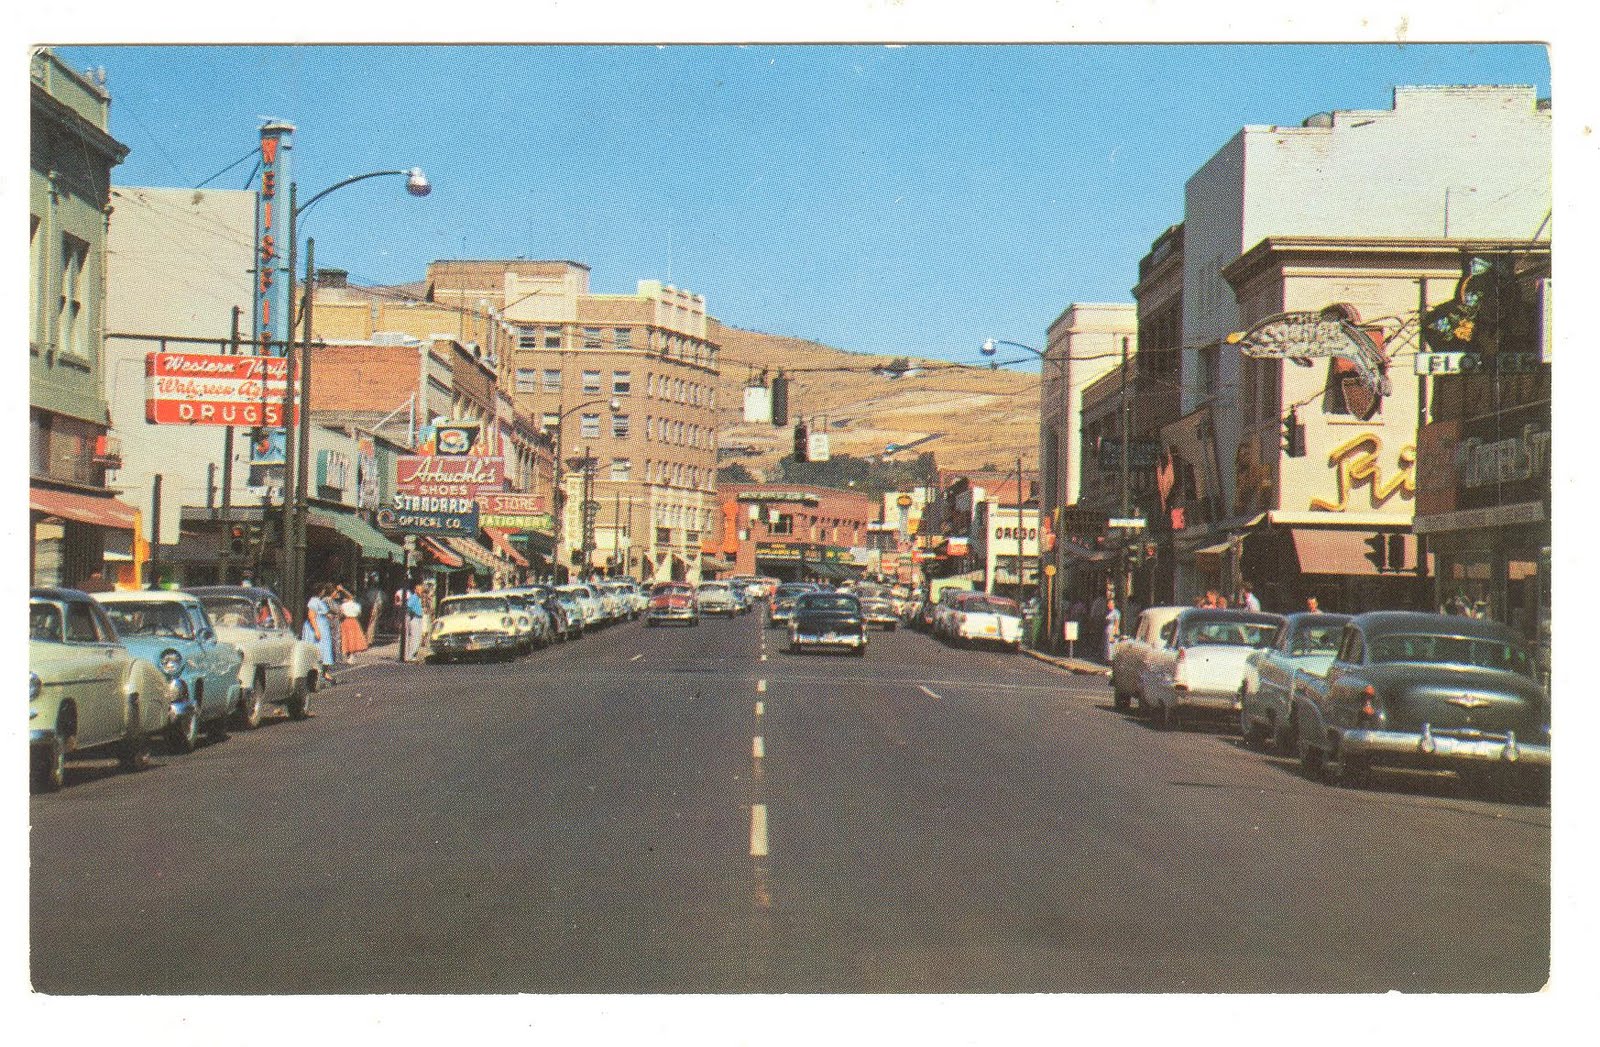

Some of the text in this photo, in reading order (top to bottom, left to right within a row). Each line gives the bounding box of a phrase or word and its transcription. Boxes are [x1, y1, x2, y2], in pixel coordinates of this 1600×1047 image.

[164, 355, 236, 373] Western
[178, 404, 278, 423] DRUGS
[403, 454, 497, 483] Arbuckle's
[420, 485, 468, 496] SHOES
[393, 494, 470, 513] STANDARD
[494, 497, 538, 510] STORE
[399, 516, 442, 529] OPTICAL
